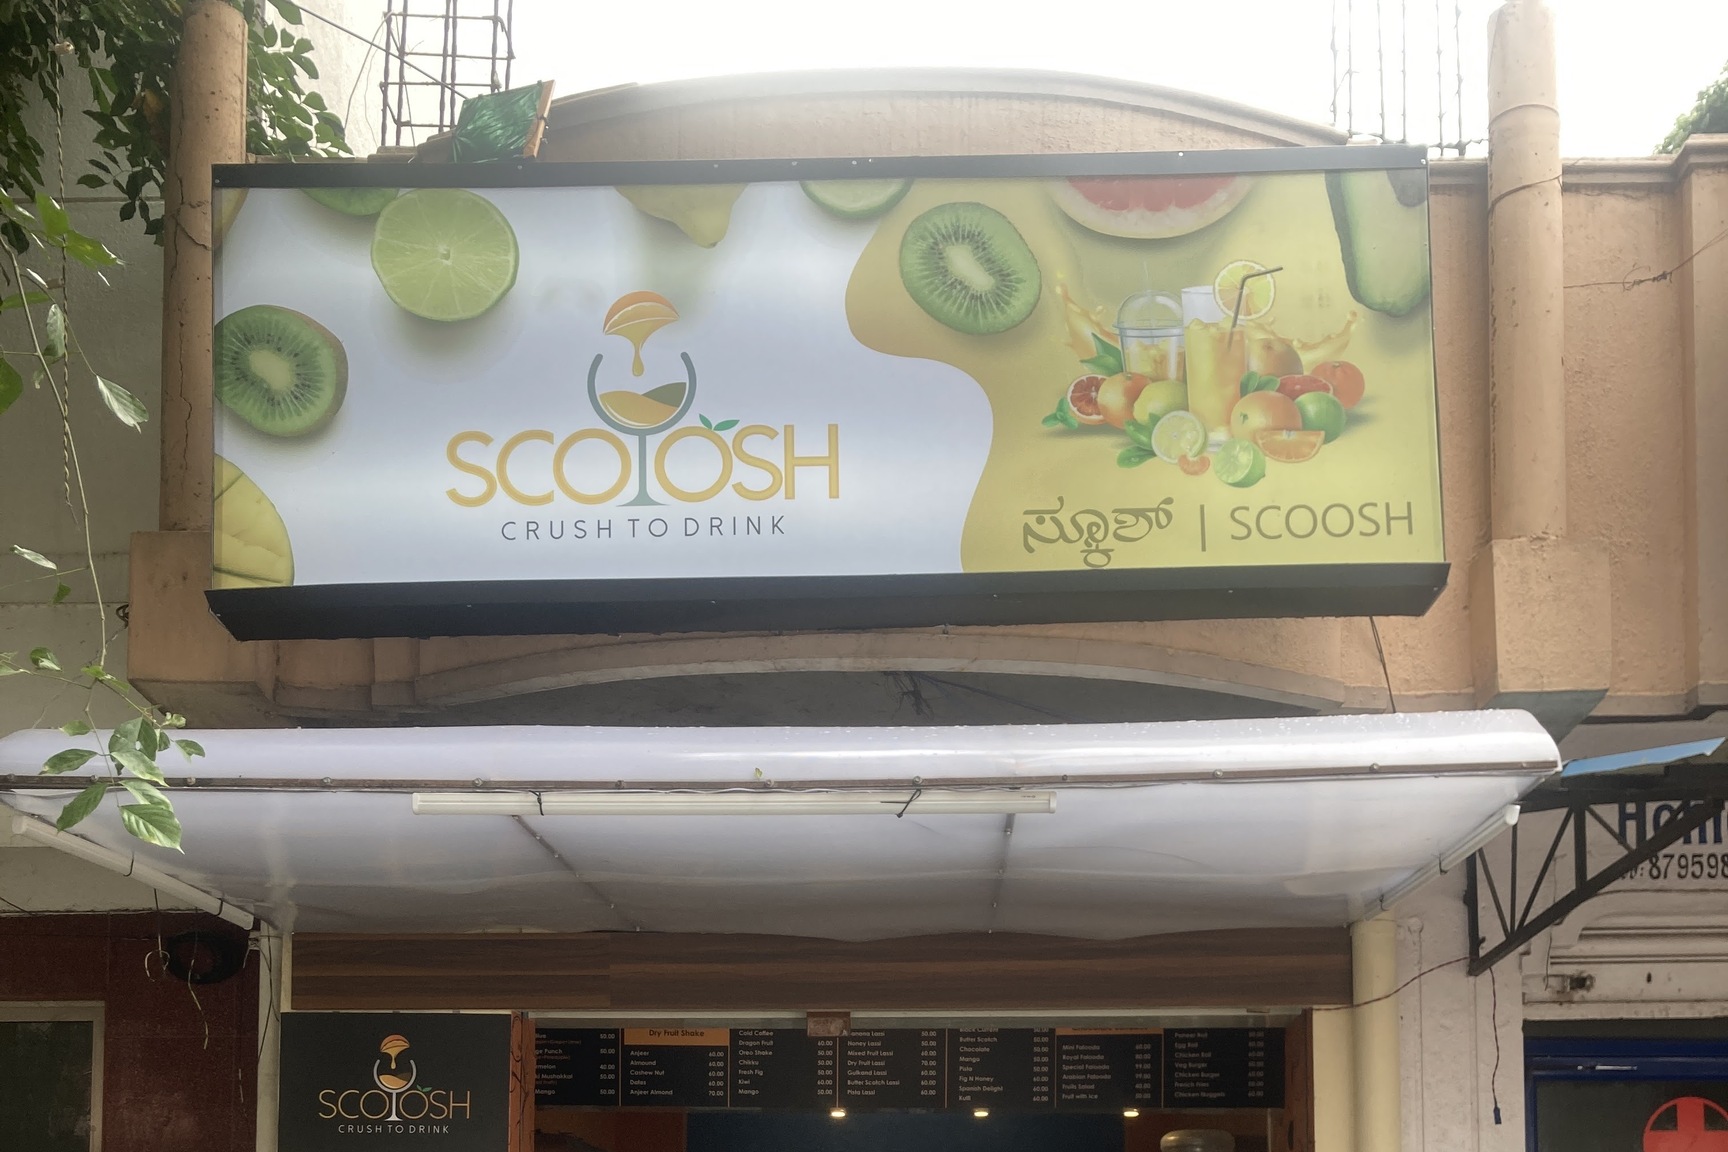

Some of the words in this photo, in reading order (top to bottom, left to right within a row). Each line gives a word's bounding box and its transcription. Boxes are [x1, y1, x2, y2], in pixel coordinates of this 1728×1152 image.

[445, 424, 840, 507] SCOOSH
[501, 519, 612, 541] CRUSH
[627, 518, 669, 539] TO
[684, 515, 785, 537] DRINK
[1229, 501, 1414, 540] SCOOSH
[649, 1029, 661, 1038] Dry
[664, 1029, 679, 1037] Fruit
[681, 1029, 705, 1037] Shake
[318, 1089, 471, 1120] SCOOSH
[338, 1124, 383, 1134] CRUSH
[387, 1124, 404, 1134] TO
[409, 1124, 450, 1134] DRINK
